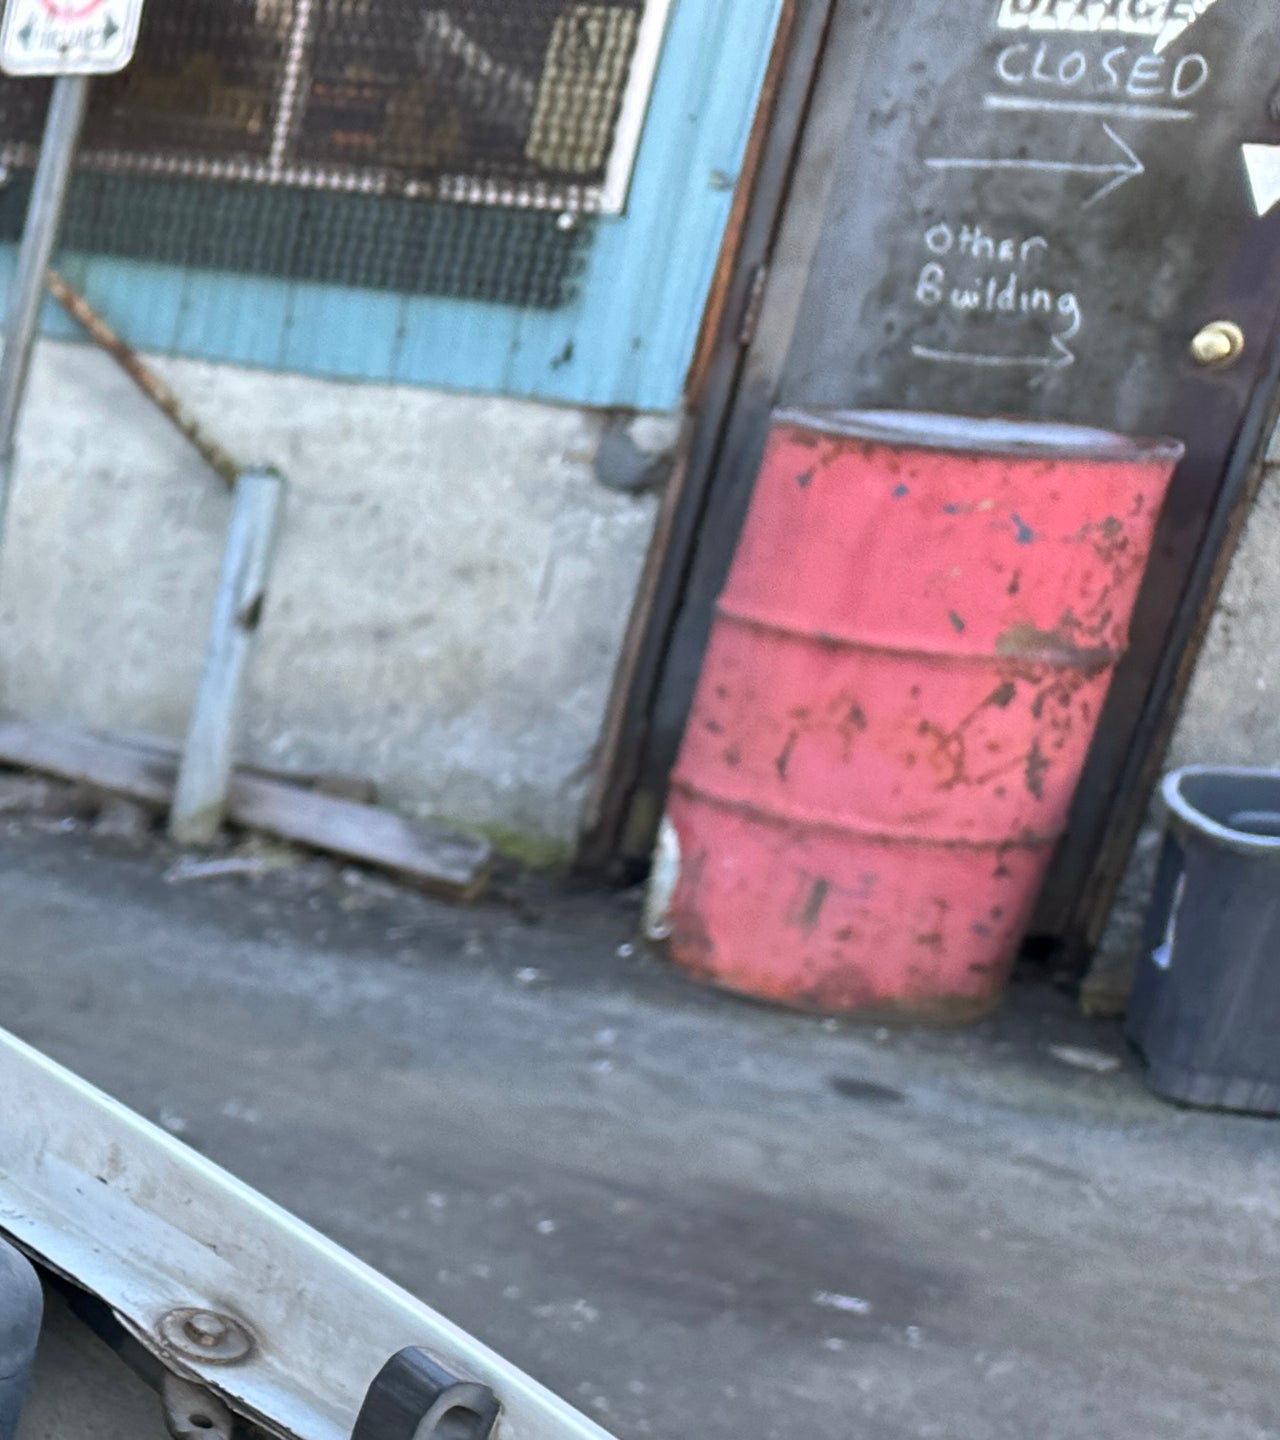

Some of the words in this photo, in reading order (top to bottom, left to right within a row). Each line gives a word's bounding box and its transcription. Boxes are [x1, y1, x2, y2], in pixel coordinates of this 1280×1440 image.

[996, 42, 1209, 98] CLOSED
[924, 222, 1048, 262] Other
[915, 262, 1081, 338] Building
